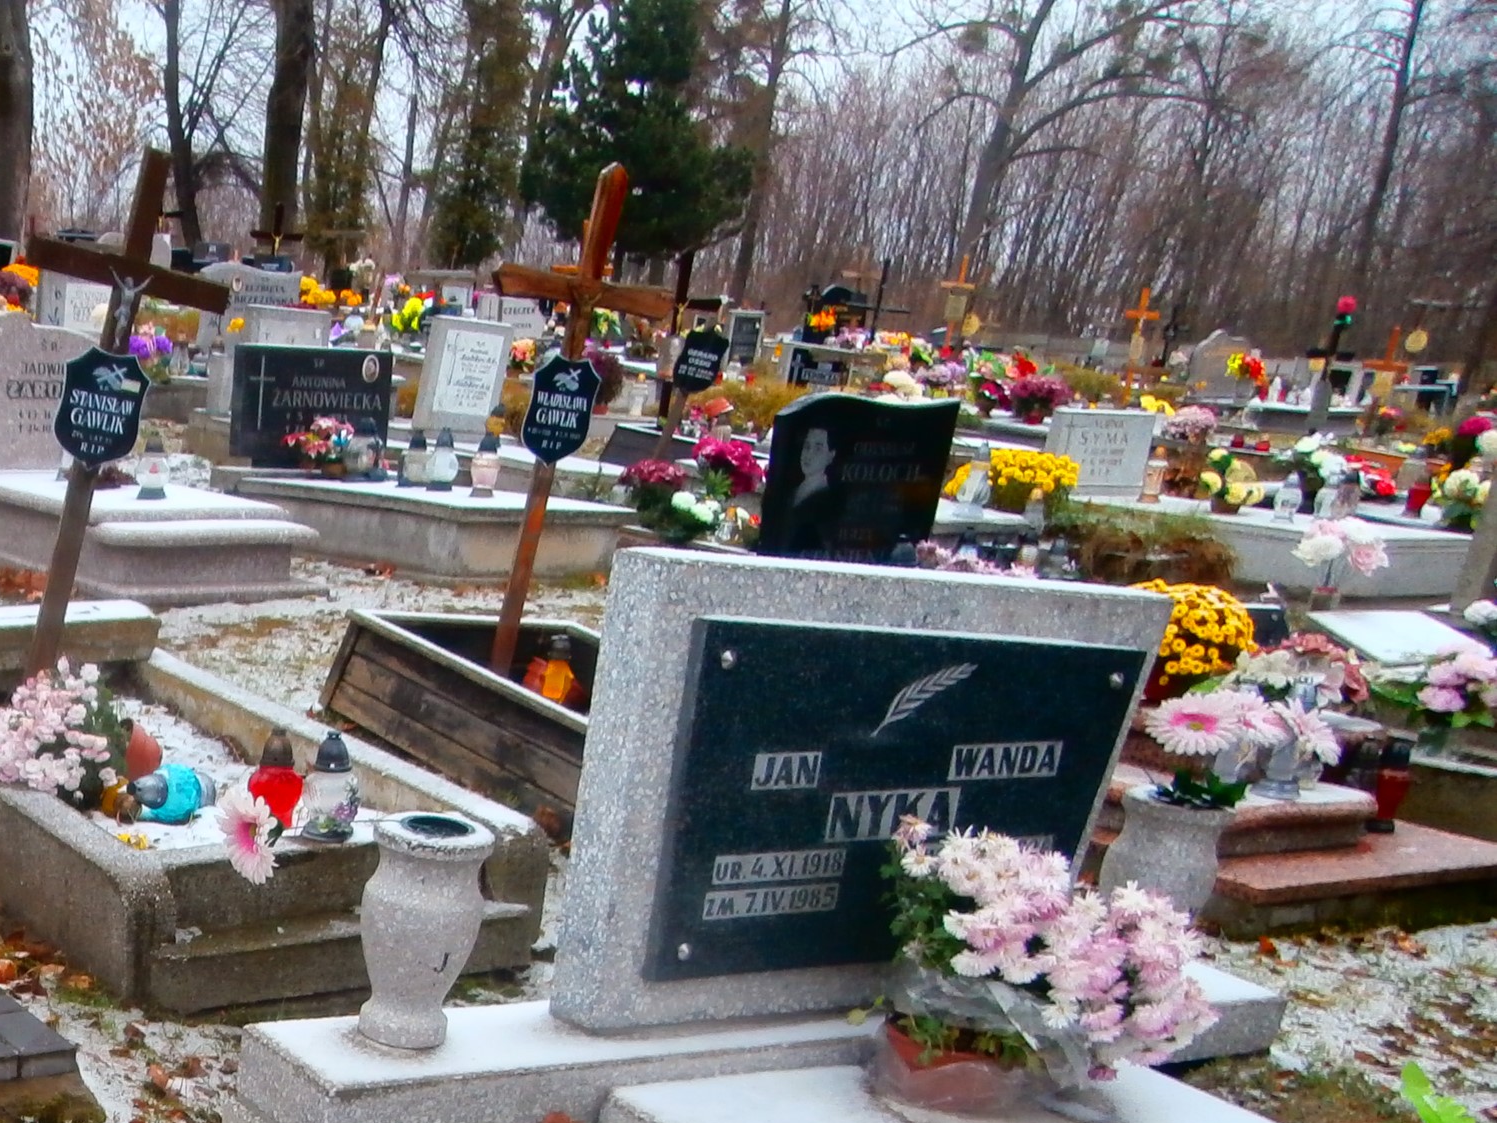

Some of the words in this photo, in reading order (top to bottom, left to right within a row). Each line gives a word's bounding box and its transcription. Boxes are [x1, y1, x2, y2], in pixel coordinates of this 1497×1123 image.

[291, 375, 347, 389] ANTONINA
[69, 388, 136, 416] STANISŁAW
[271, 387, 382, 411] ŻARNOWIECKA
[70, 407, 126, 435] GAWLIK
[535, 407, 579, 429] GAWLIK
[1079, 431, 1128, 445] SYMA
[754, 754, 819, 787] JAN
[954, 745, 1055, 778] WANDA
[828, 790, 952, 840] NYKA
[715, 860, 746, 881] UR.
[704, 896, 739, 918] ZM.
